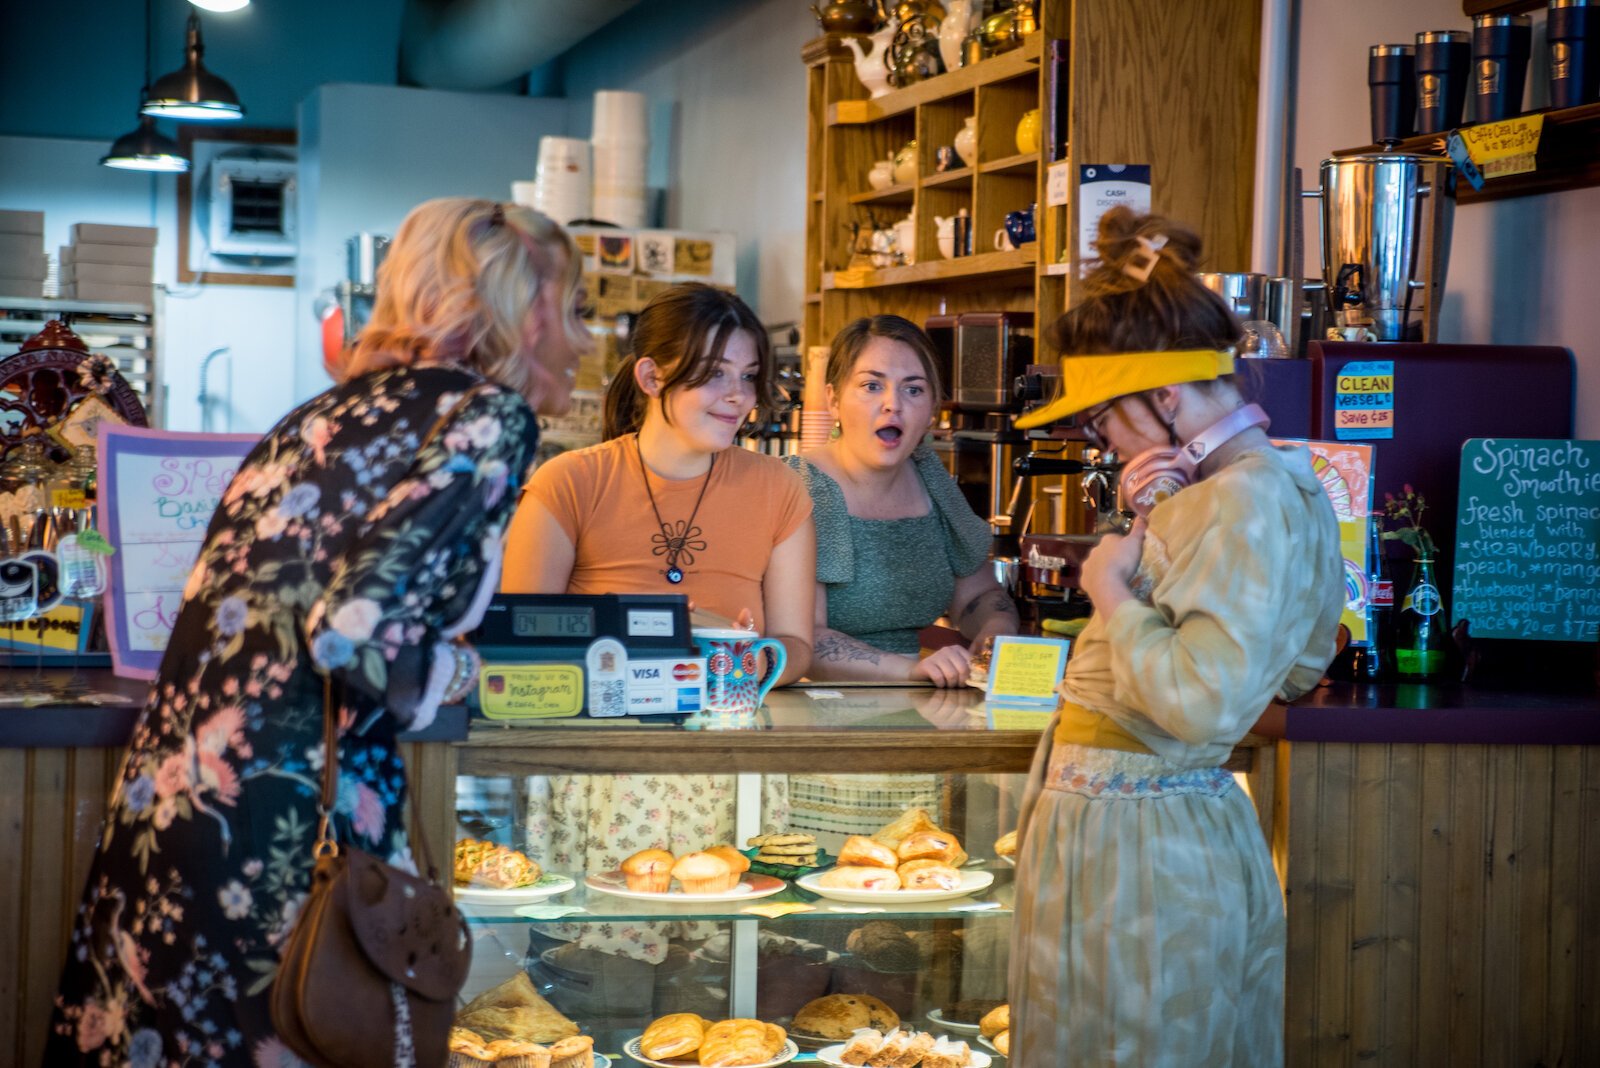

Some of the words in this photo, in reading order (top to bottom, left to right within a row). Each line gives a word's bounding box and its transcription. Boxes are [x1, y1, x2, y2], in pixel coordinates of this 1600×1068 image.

[1105, 189, 1127, 197] CASH
[1339, 377, 1390, 391] CLEAN
[1341, 411, 1368, 425] Save
[1473, 438, 1590, 480] Spinach
[1503, 469, 1600, 499] Smoothie
[1479, 522, 1535, 539] blended
[1546, 522, 1585, 539] with
[1468, 615, 1506, 633] juice
[1522, 618, 1540, 636] 20
[631, 668, 661, 680] VISA
